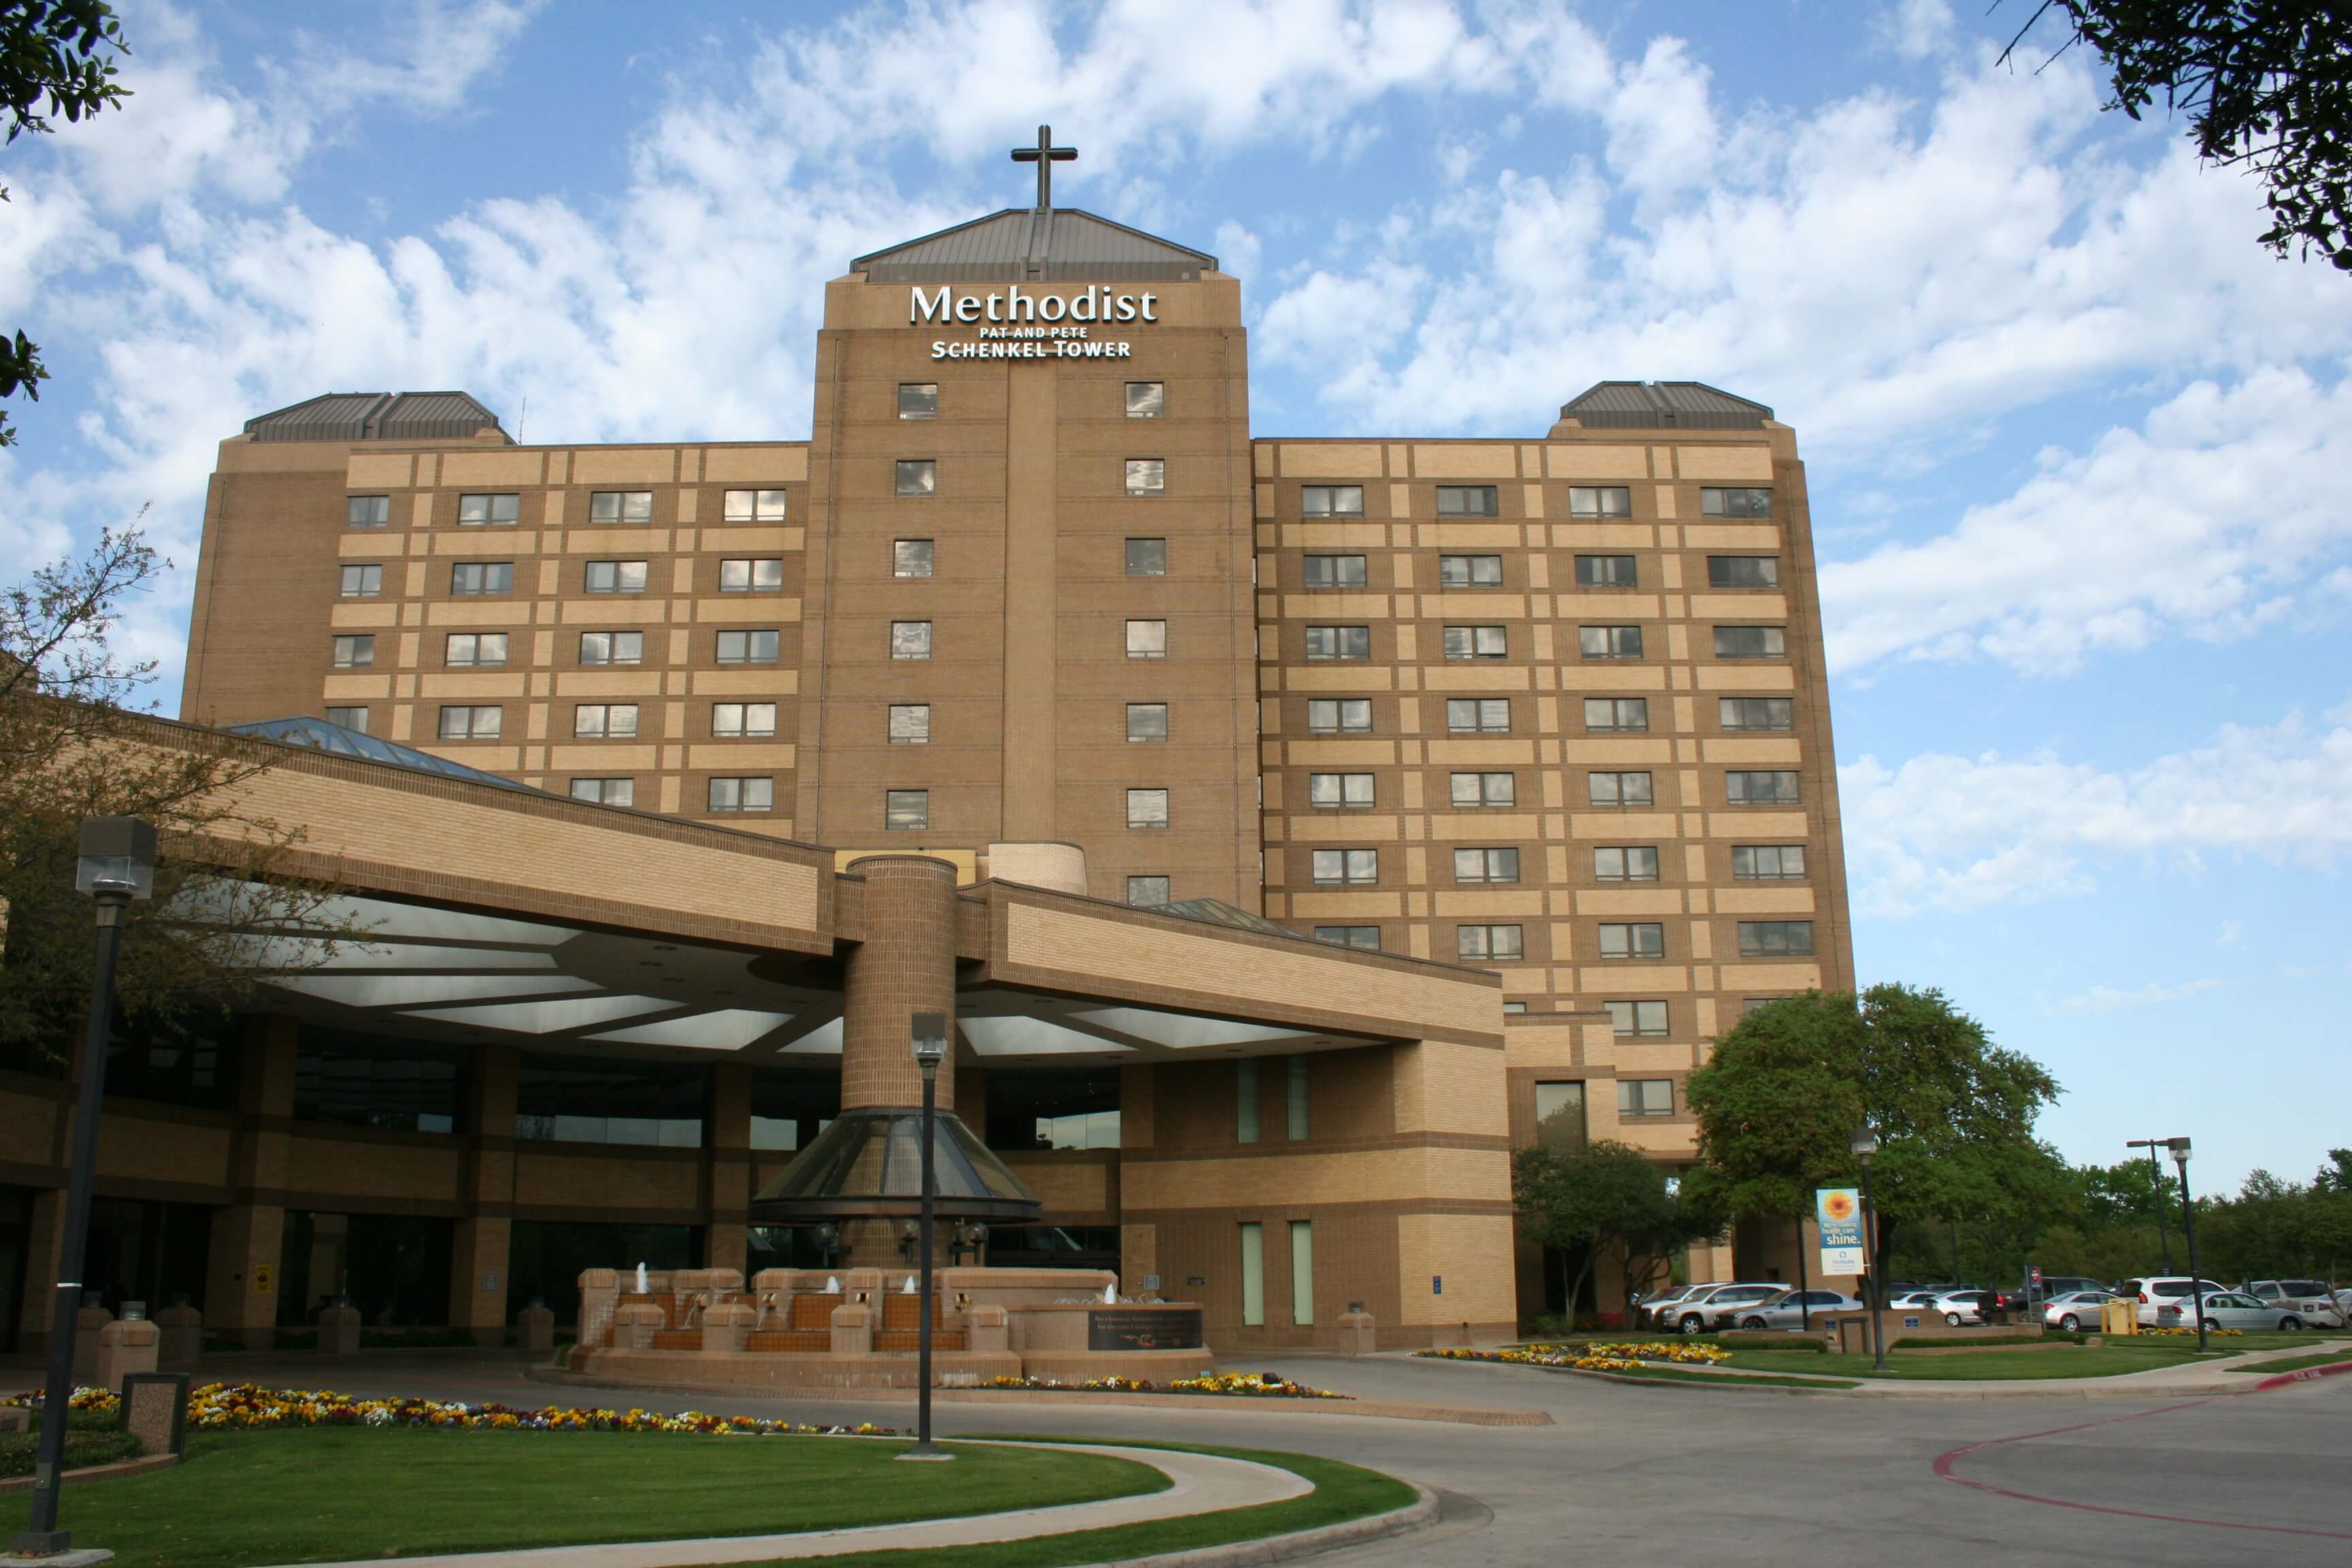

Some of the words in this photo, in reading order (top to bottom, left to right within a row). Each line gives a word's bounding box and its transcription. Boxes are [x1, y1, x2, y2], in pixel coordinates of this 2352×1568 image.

[910, 285, 1158, 322] Methodist
[980, 327, 1007, 338] PAT
[1013, 327, 1045, 338] AND
[1051, 327, 1087, 338] PETE
[932, 341, 1046, 358] SCHENKEL
[1054, 340, 1130, 357] TOWER
[1827, 1233, 1861, 1245] shine.
